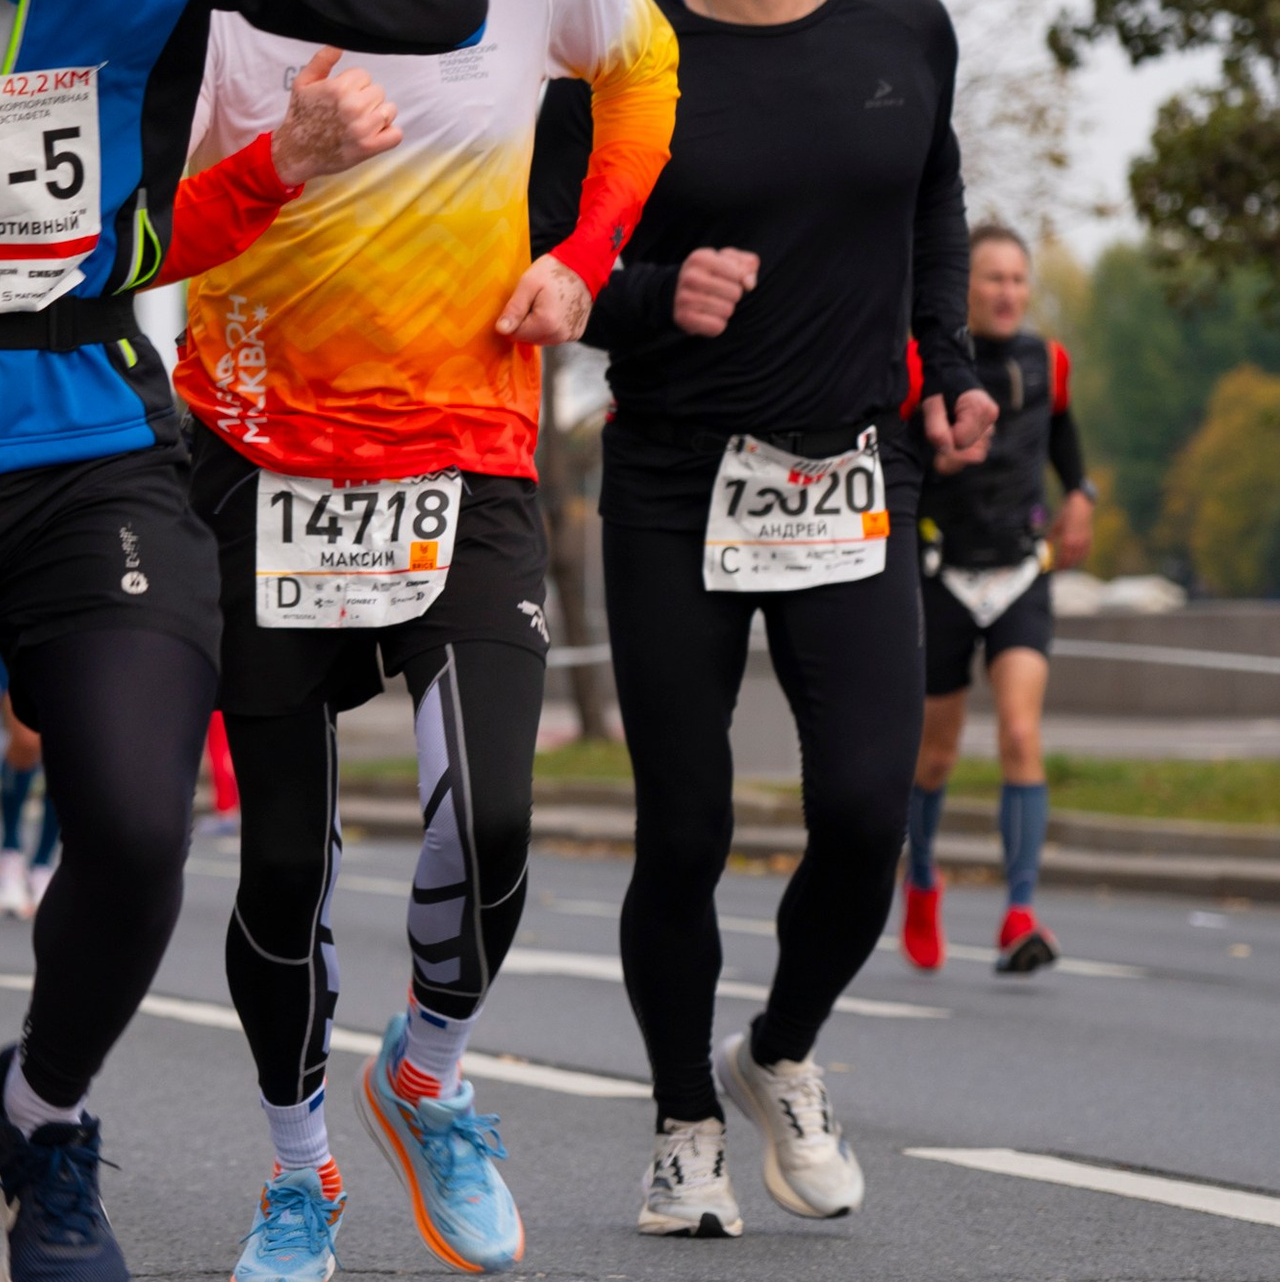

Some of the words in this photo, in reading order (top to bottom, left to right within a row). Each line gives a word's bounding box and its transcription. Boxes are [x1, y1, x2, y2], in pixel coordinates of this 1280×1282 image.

[2, 74, 48, 97] 42,2
[271, 489, 450, 545] 14718
[758, 519, 828, 539] АНДРЕЙ
[320, 550, 396, 568] МАКСИМ
[276, 577, 302, 609] D
